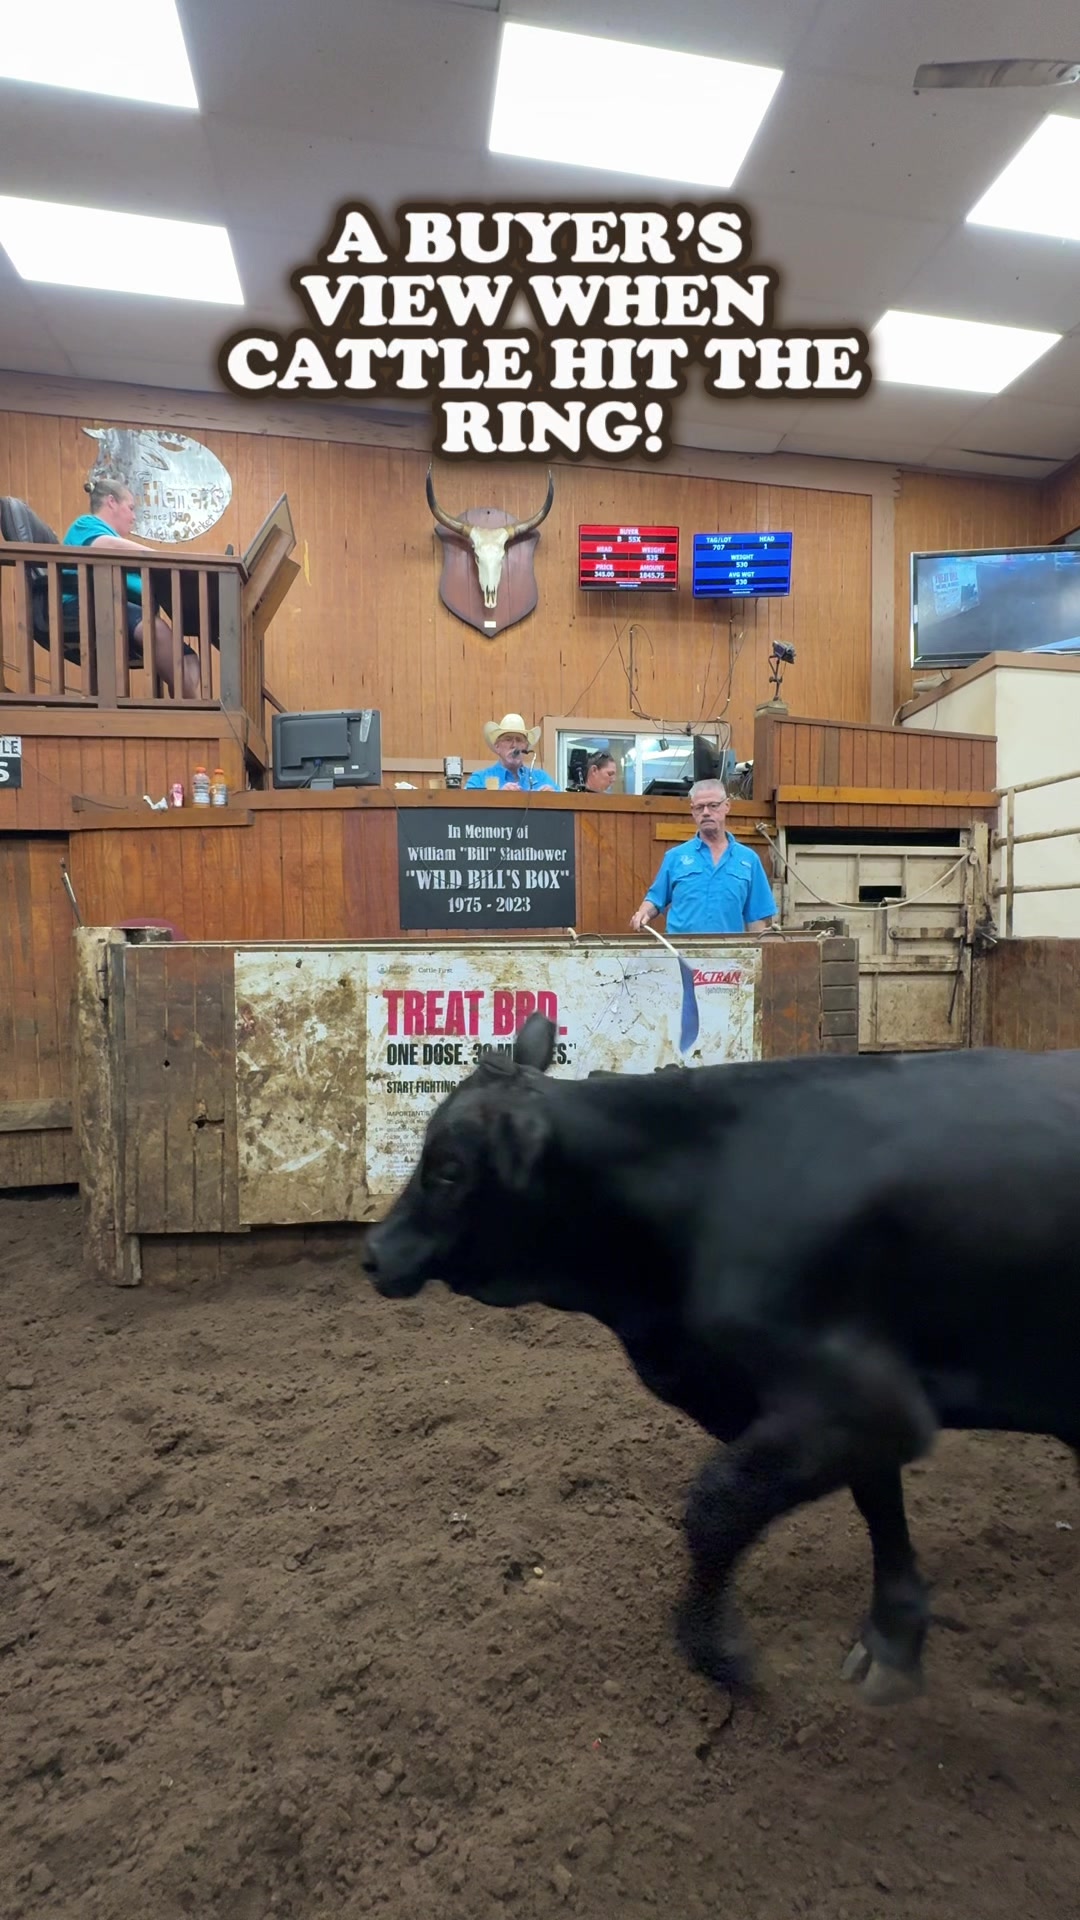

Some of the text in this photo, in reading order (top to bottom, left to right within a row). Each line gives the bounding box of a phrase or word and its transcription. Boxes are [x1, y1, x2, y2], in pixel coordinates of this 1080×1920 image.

[448, 824, 529, 840] In Memory of
[408, 847, 456, 861] William
[460, 847, 496, 861] "Bill"
[406, 869, 570, 890] "WILD BILL'S BOX"
[448, 897, 482, 913] 1975
[496, 897, 531, 912] 2023
[382, 990, 485, 1036] TREAT
[386, 1043, 418, 1066] ONE
[423, 1043, 468, 1066] DOSE.
[386, 1080, 456, 1094] START FIGHTING
